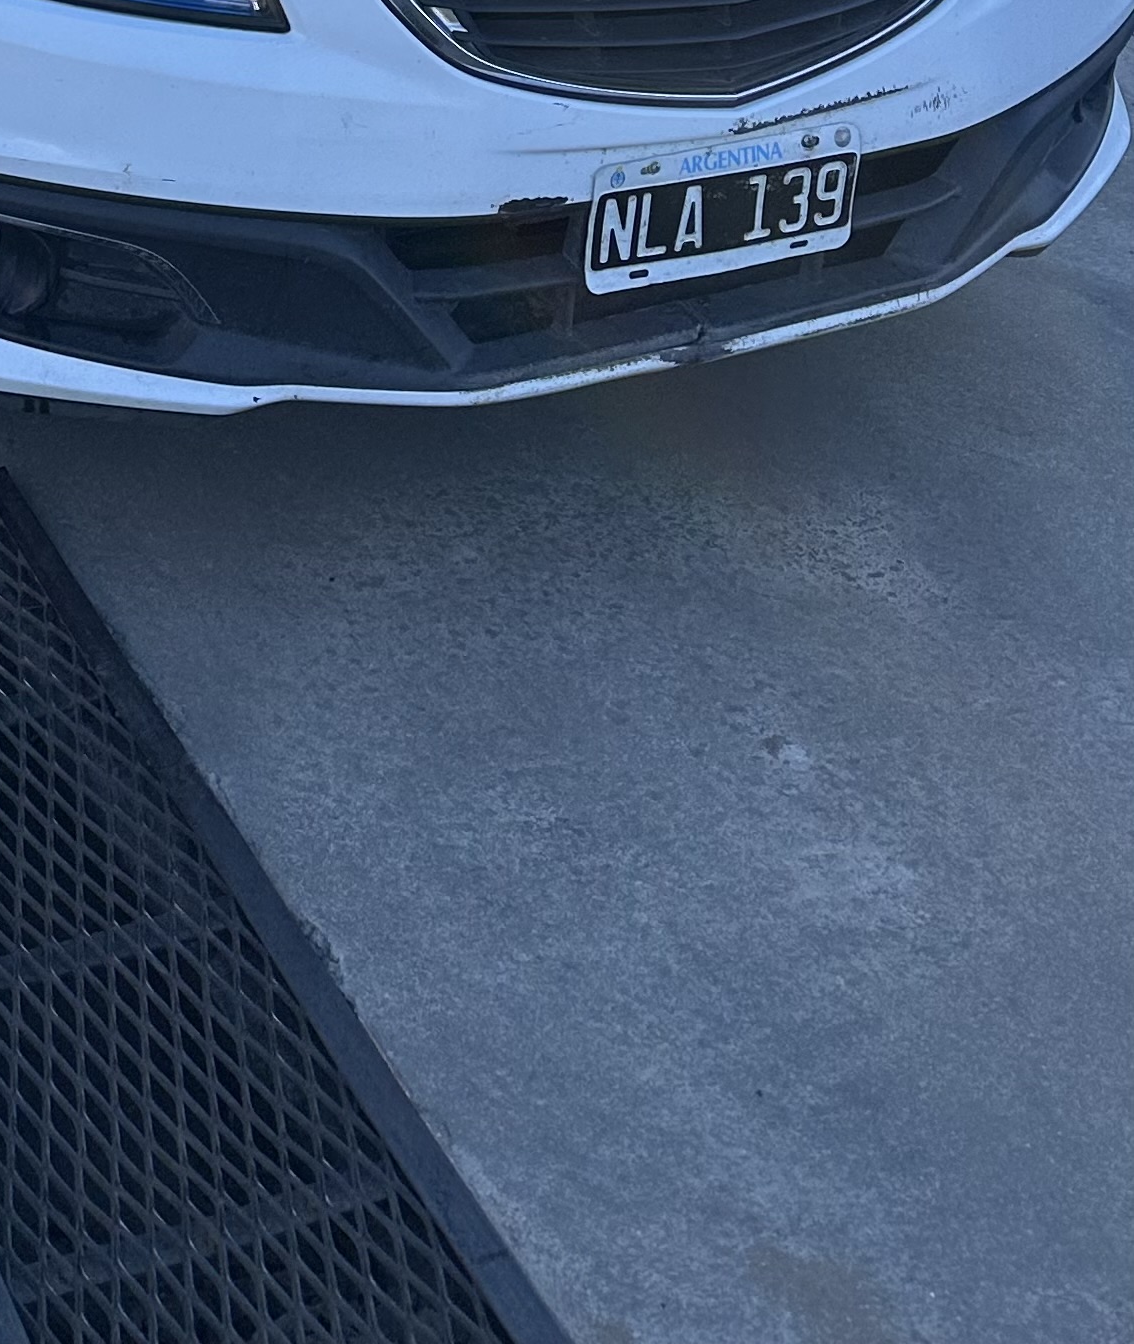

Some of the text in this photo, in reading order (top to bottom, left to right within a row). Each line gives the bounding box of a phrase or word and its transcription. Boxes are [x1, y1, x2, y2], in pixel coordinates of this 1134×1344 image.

[678, 141, 783, 176] ARGENTINA
[599, 160, 848, 264] NLA 139
